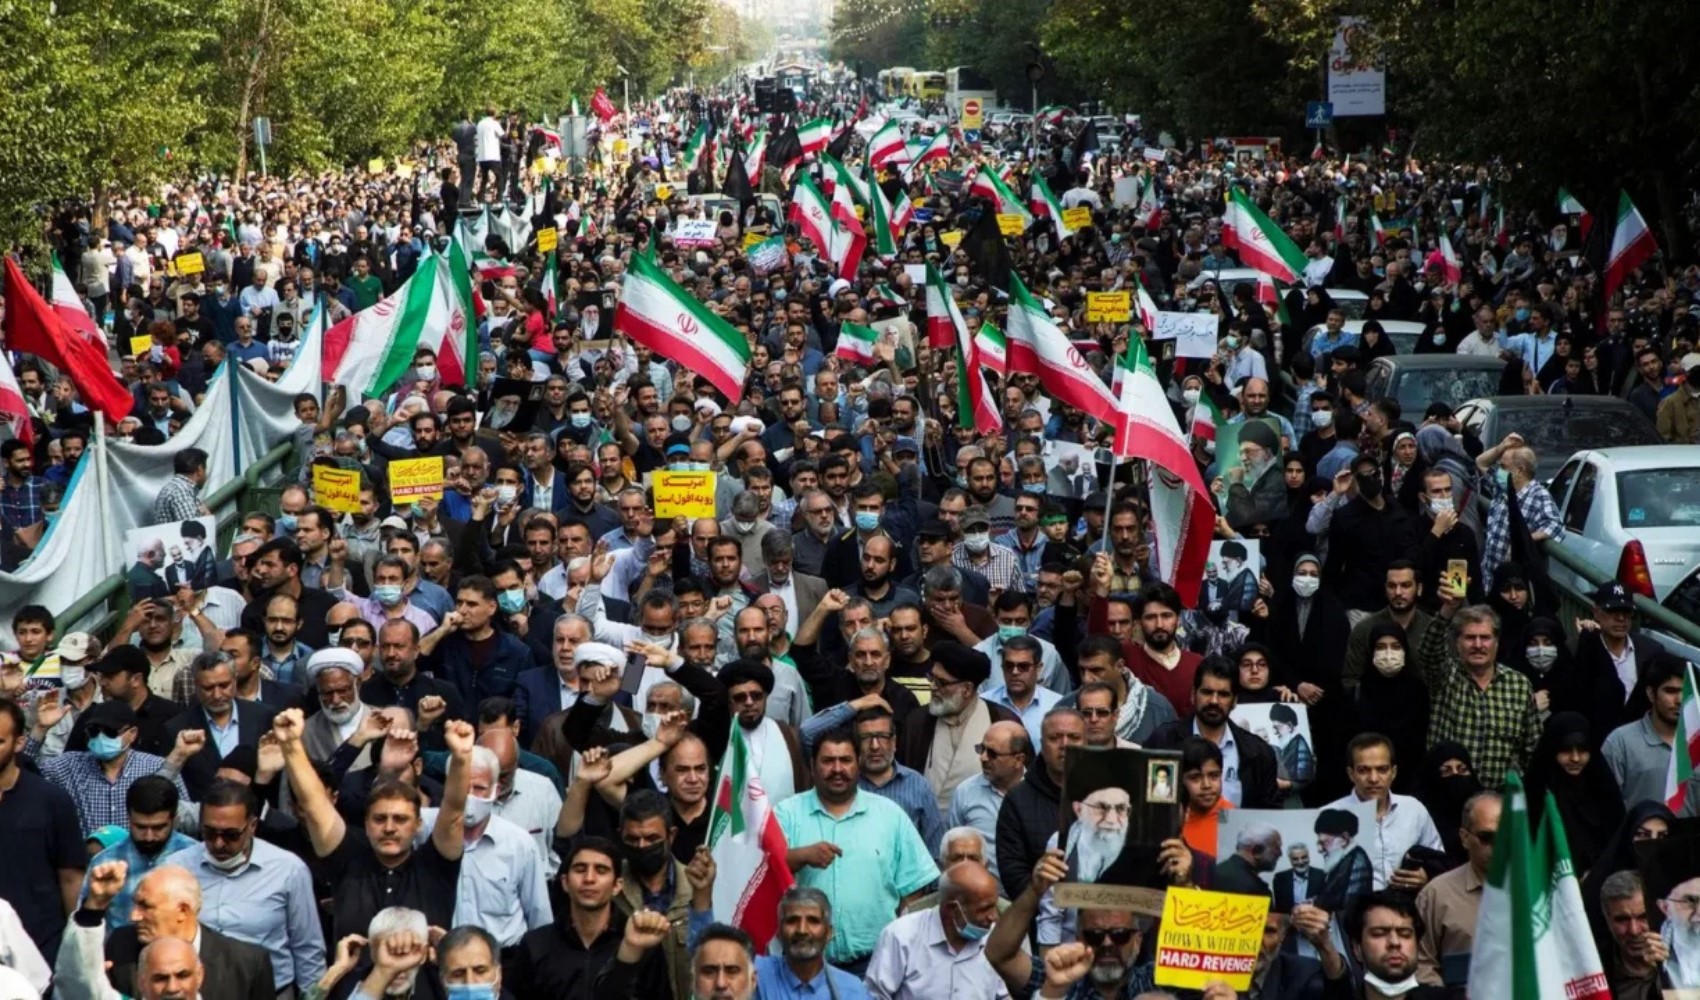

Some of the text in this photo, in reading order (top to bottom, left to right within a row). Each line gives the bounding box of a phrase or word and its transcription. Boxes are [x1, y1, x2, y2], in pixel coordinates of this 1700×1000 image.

[656, 493, 674, 503] است
[674, 491, 694, 505] افول
[1163, 930, 1205, 949] DOWN
[1207, 935, 1236, 952] WITH
[1160, 950, 1255, 972] HARD REVENGE
